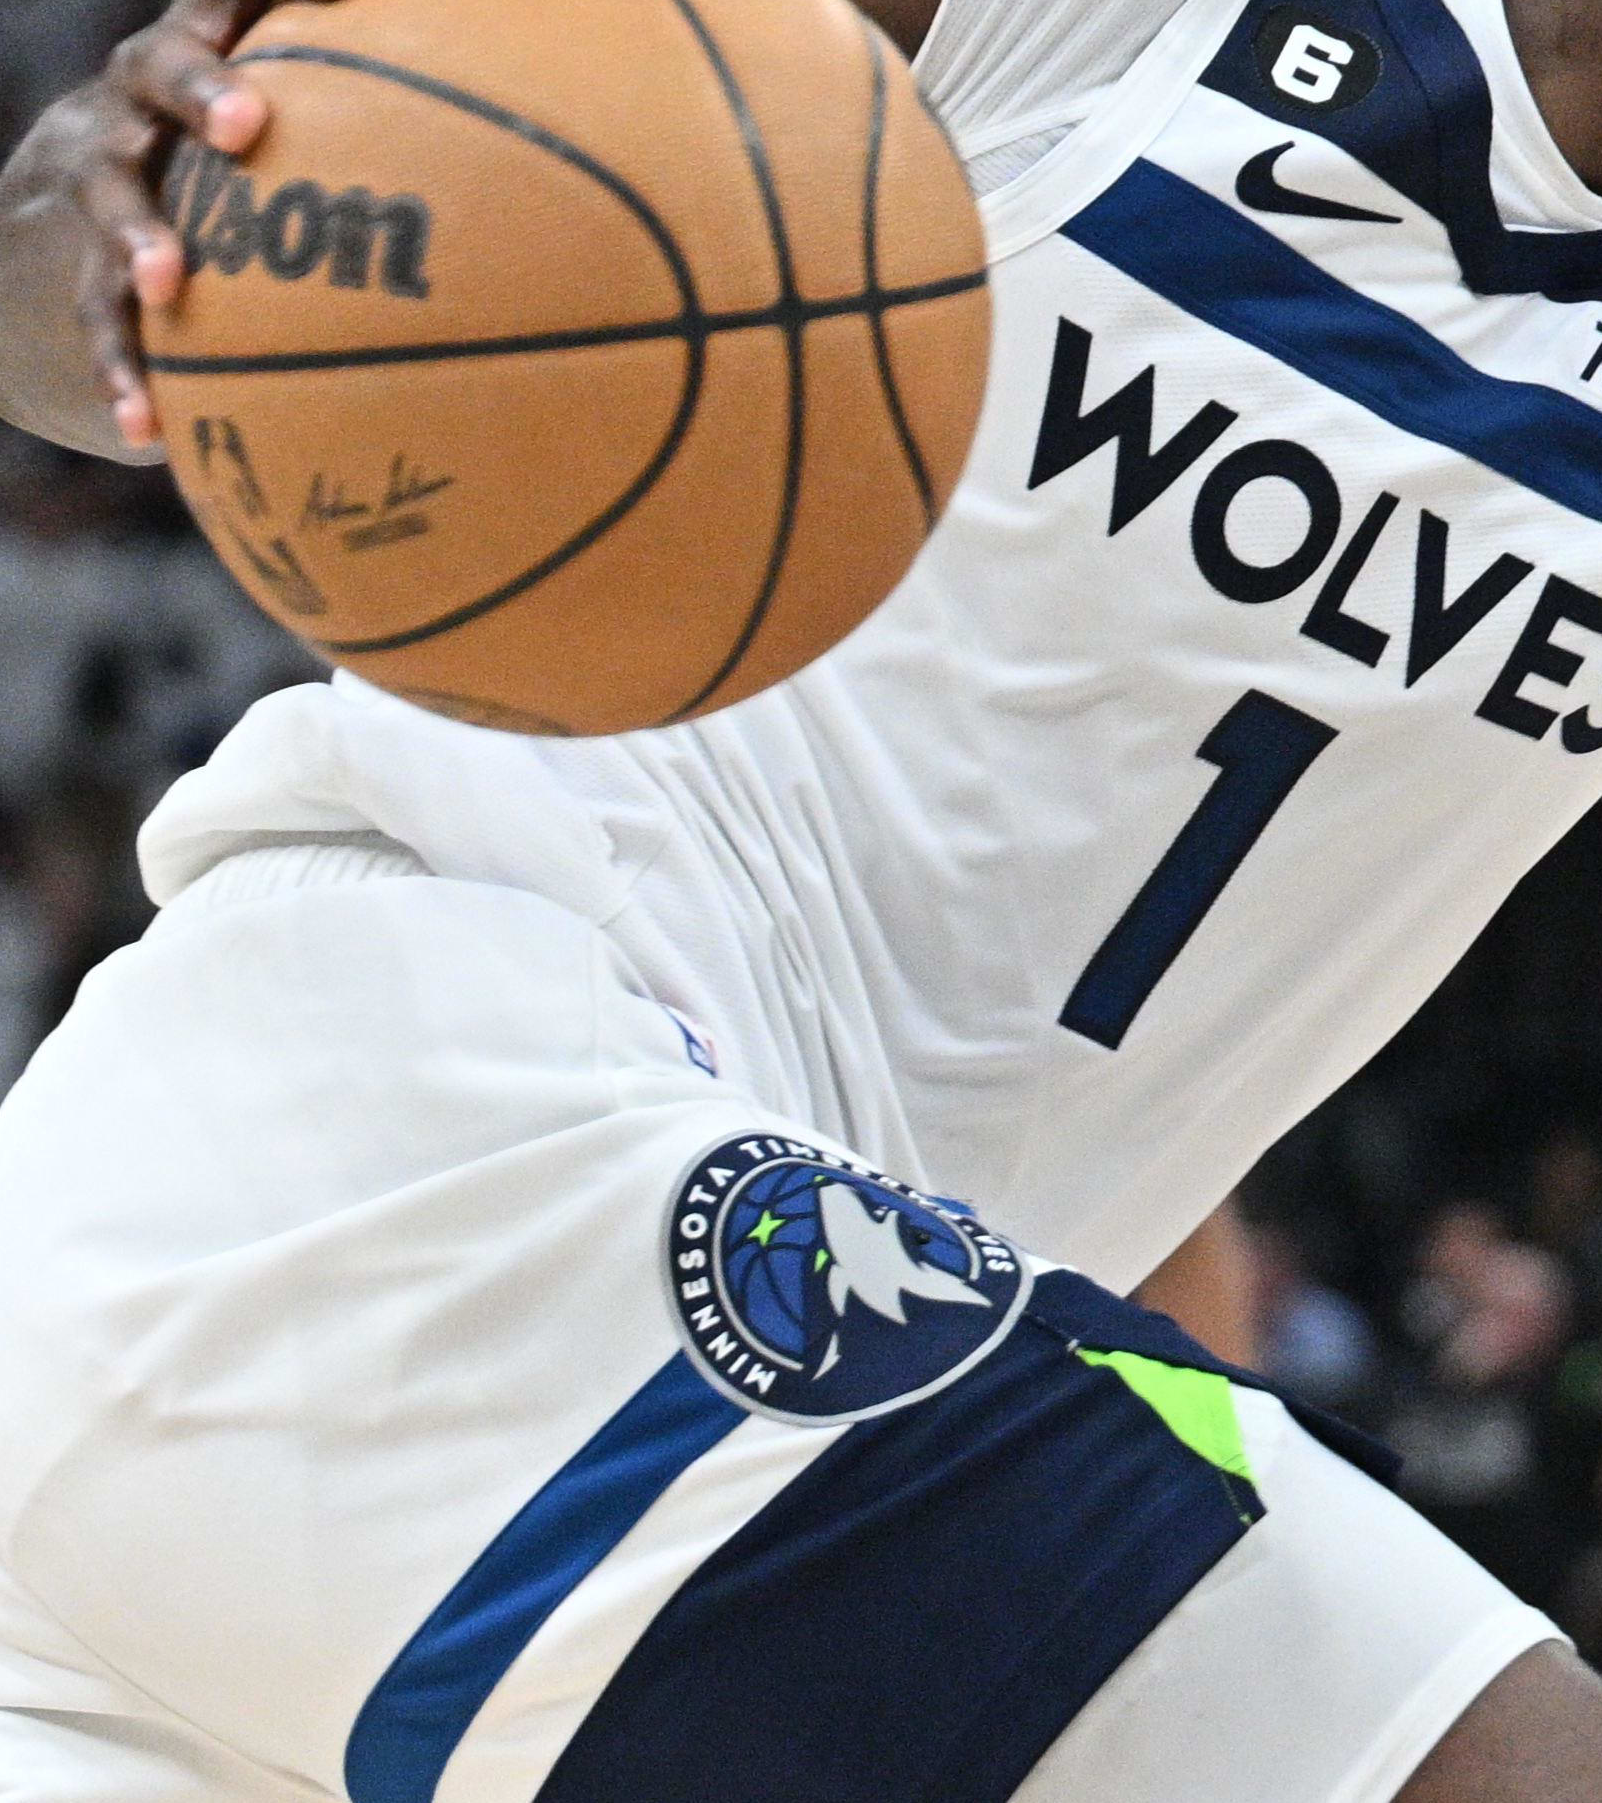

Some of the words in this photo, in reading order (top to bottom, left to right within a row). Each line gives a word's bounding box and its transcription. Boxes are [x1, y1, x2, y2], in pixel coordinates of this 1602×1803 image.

[1270, 23, 1351, 104] 6
[1057, 687, 1341, 1051] 1
[677, 1165, 778, 1395] MINNESOTA
